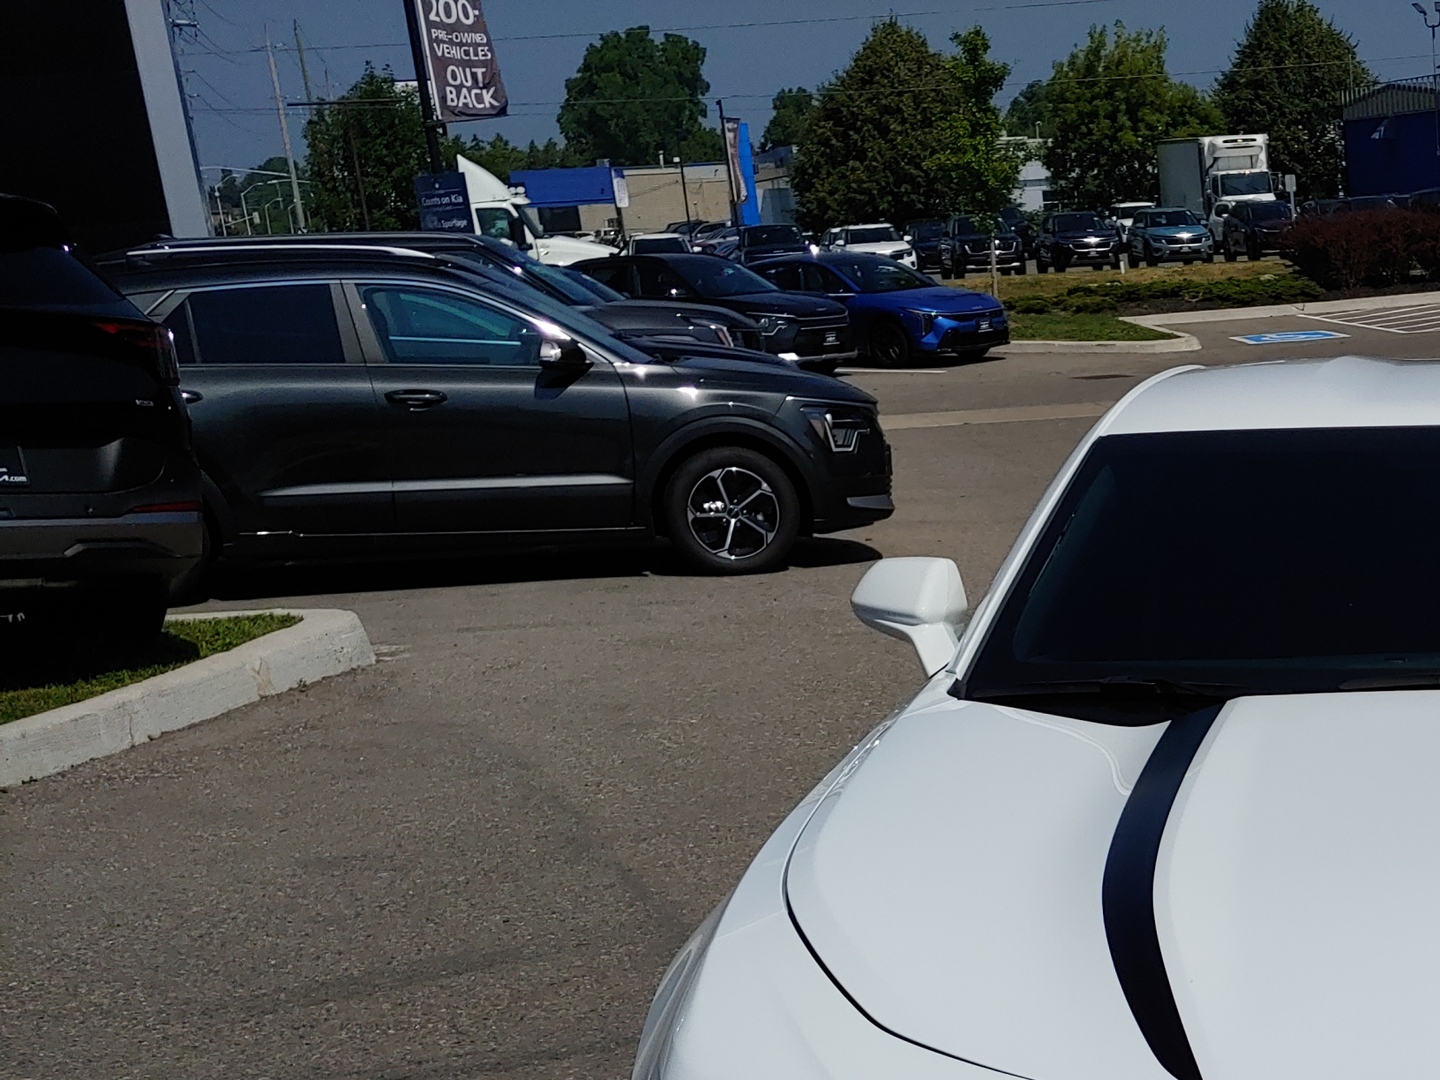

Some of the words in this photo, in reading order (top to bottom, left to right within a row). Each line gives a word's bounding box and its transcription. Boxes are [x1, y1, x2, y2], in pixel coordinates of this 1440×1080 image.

[430, 28, 487, 43] PRE-OWNED
[433, 43, 492, 60] VEHICLES
[446, 65, 486, 87] OUT
[445, 86, 501, 109] BACK
